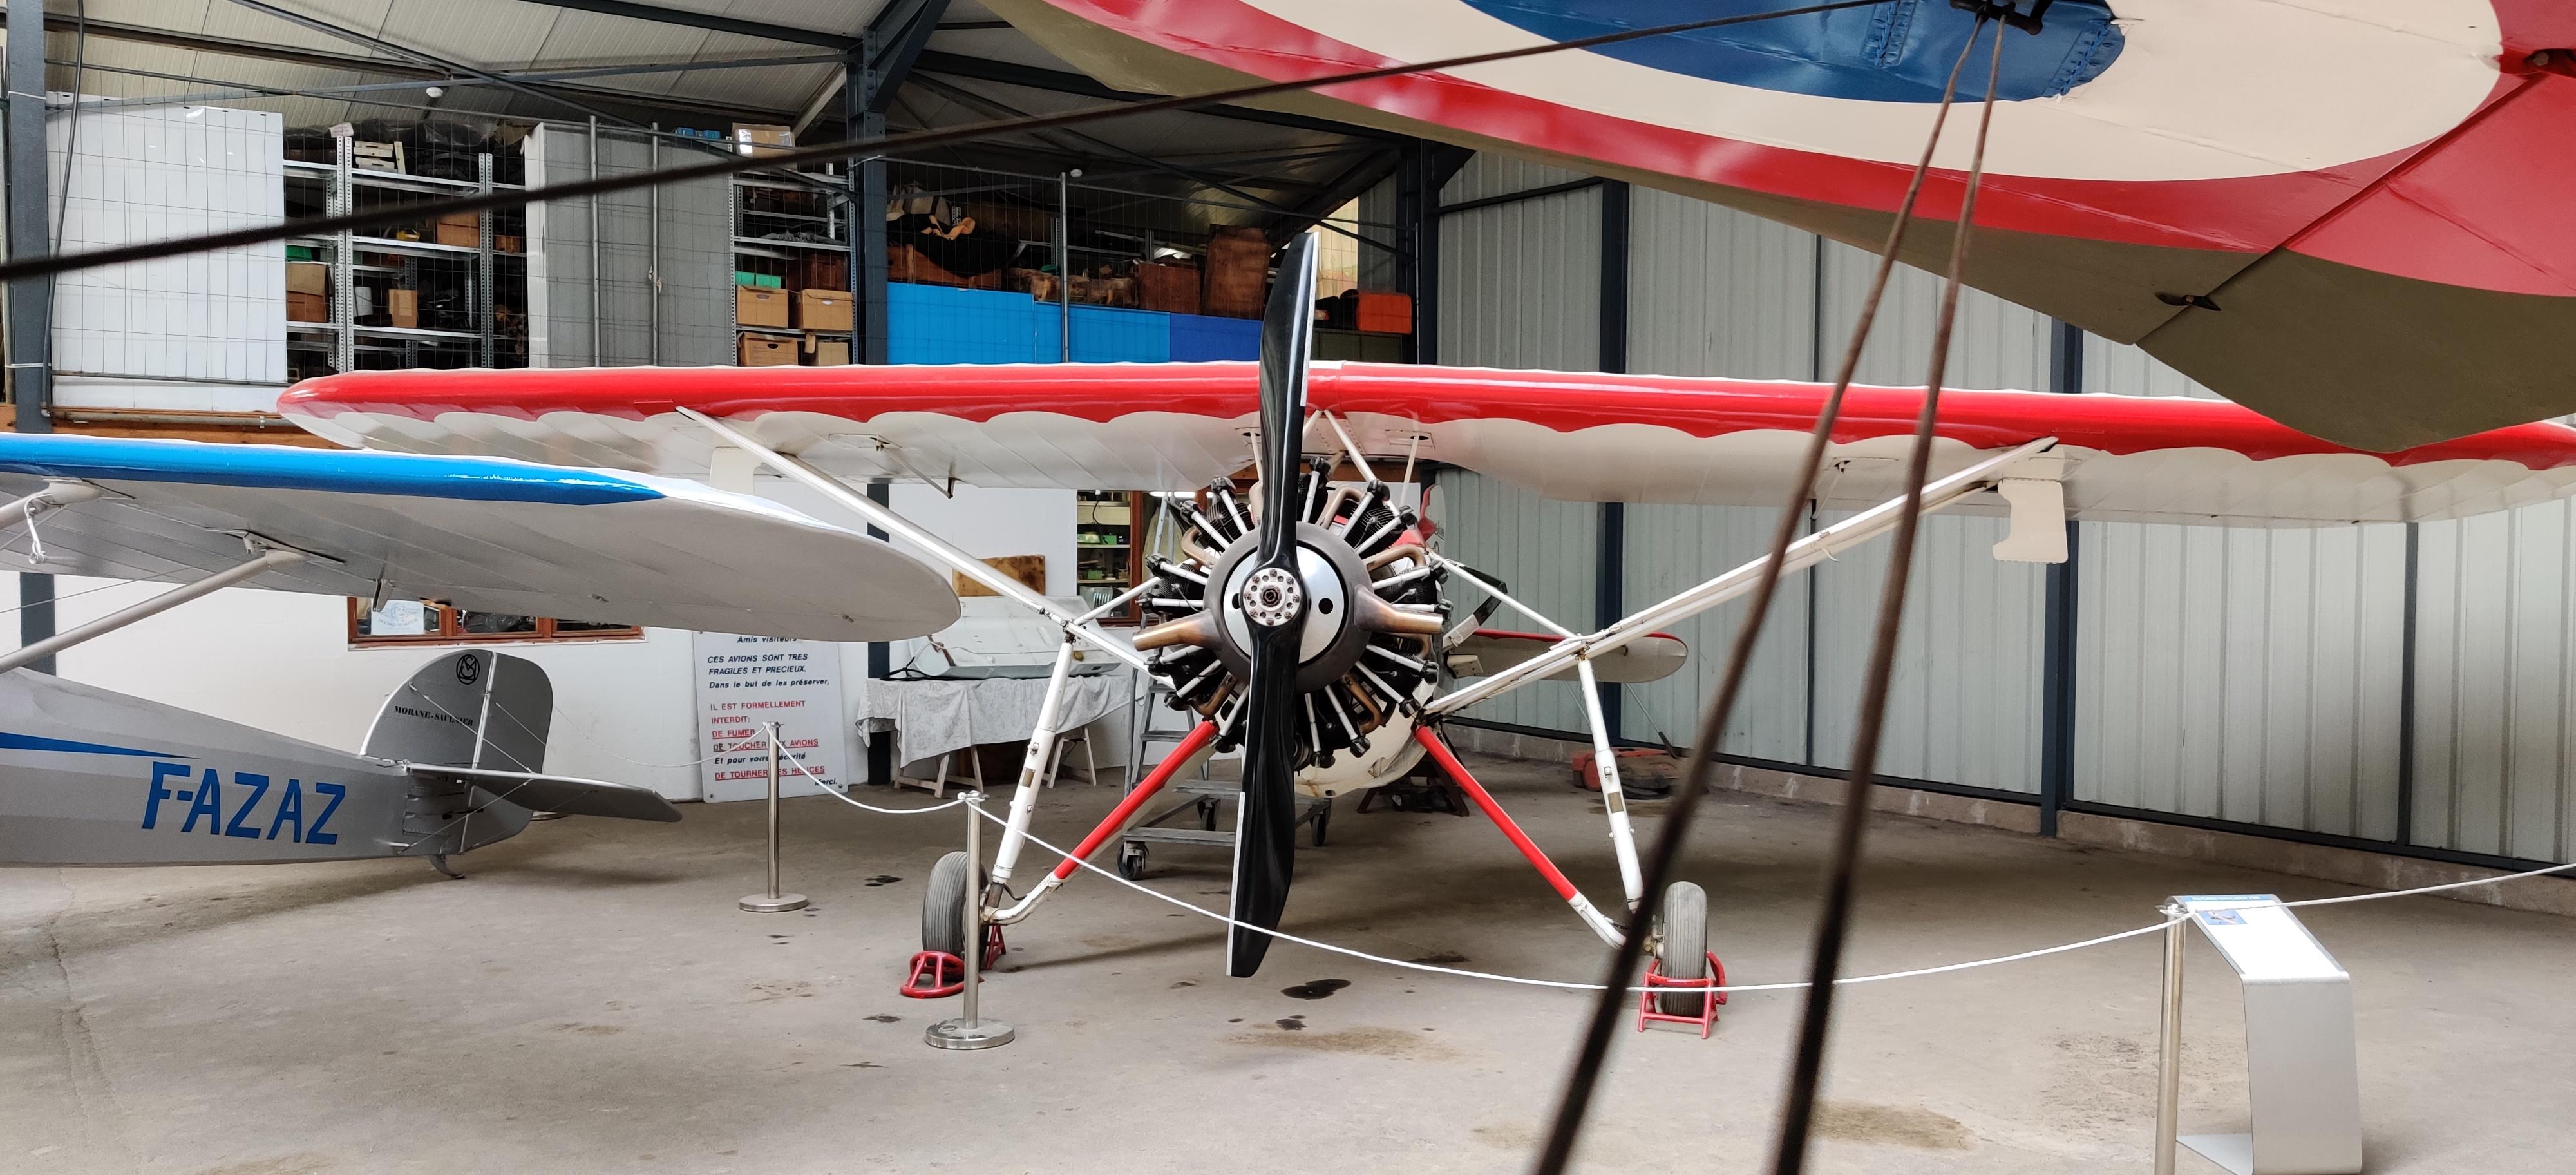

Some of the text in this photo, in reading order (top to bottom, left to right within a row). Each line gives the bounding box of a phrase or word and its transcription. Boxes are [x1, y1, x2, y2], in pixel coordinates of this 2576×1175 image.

[790, 678, 829, 687] préserver,
[741, 700, 806, 709] FORMELLEMENT
[711, 716, 750, 724] INTERDIT:
[790, 738, 819, 747] AVIONS
[727, 757, 746, 765] pour
[730, 769, 768, 778] TOURNER
[791, 765, 825, 774] HEICES
[141, 760, 346, 845] F-AZAZ
